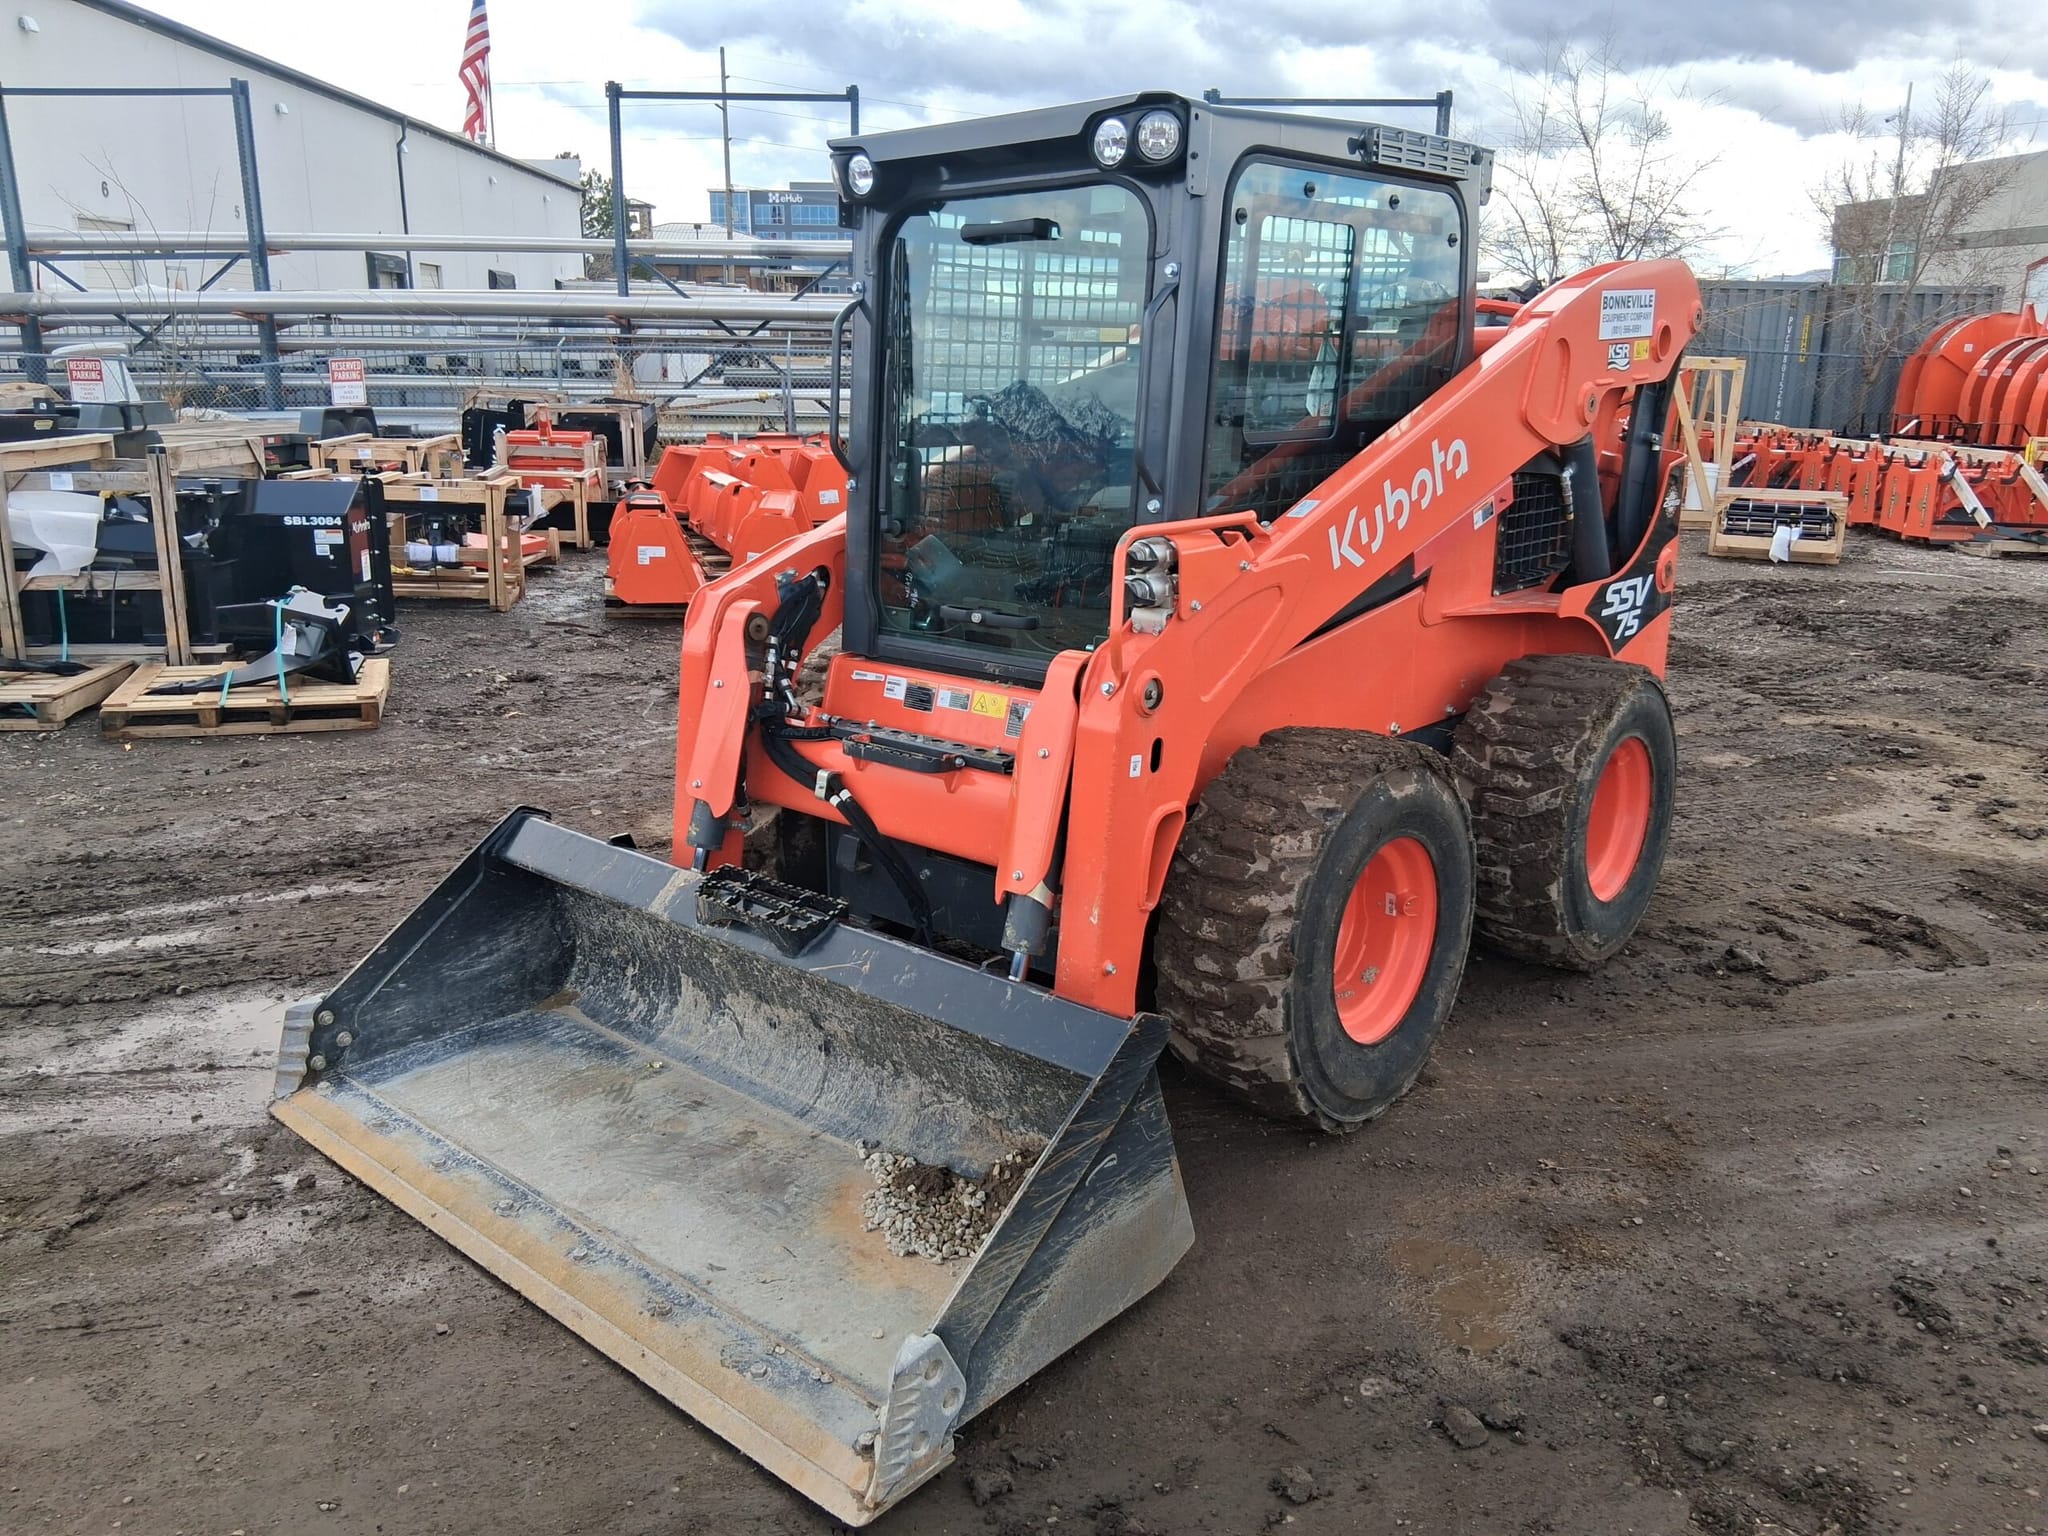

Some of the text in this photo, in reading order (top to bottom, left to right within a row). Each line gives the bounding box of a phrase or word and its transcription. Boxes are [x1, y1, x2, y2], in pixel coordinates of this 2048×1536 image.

[101, 181, 109, 198] 6
[780, 193, 803, 202] eHub
[234, 205, 240, 219] 5
[1602, 295, 1654, 310] BONNEVILLE
[1602, 312, 1652, 323] EQUIPMENT COMPANY
[1608, 344, 1630, 358] KSR
[69, 361, 101, 370] RESERVED
[331, 361, 361, 370] RESERVED
[72, 370, 102, 380] PARKING
[334, 370, 362, 380] PARKING
[1328, 438, 1468, 570] Kubota
[283, 516, 342, 526] SBL3084
[1601, 574, 1654, 617] SSV
[1613, 609, 1641, 640] 75
